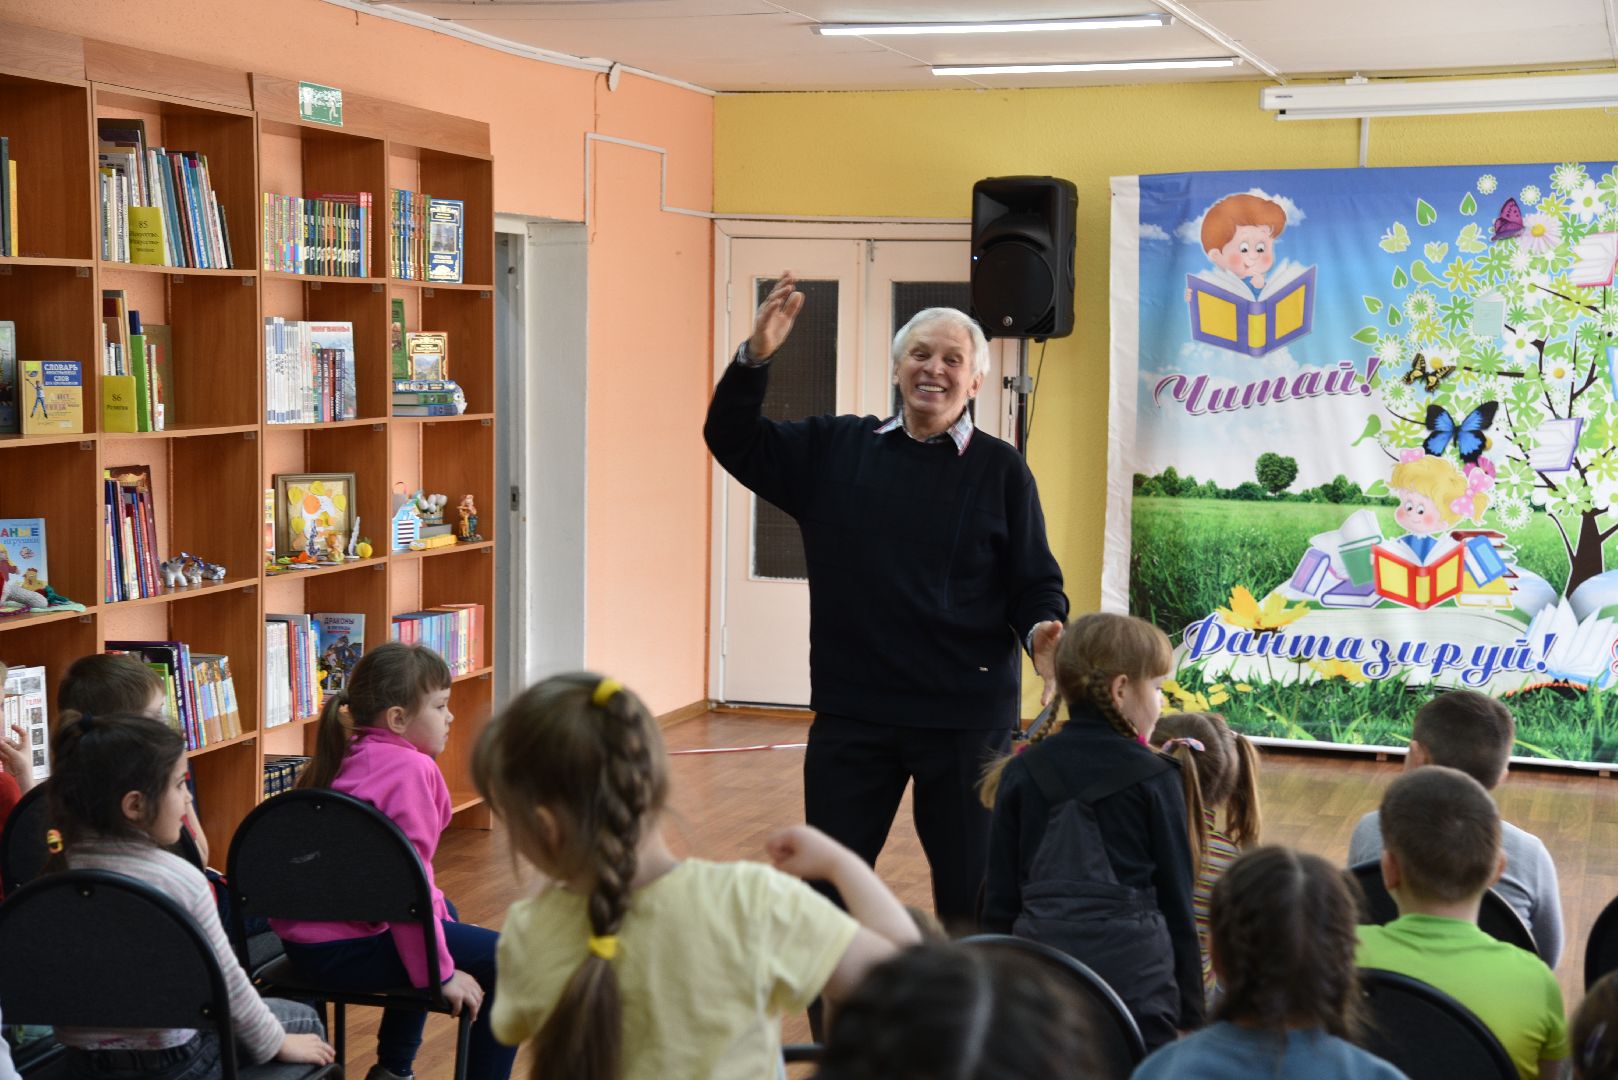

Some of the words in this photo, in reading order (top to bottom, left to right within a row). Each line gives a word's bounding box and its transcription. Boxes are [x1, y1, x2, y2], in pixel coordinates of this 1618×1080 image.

[44, 363, 79, 371] СЛОВАРЬ
[1154, 357, 1381, 415] Читай!
[1184, 613, 1557, 687] Фантазируй!
